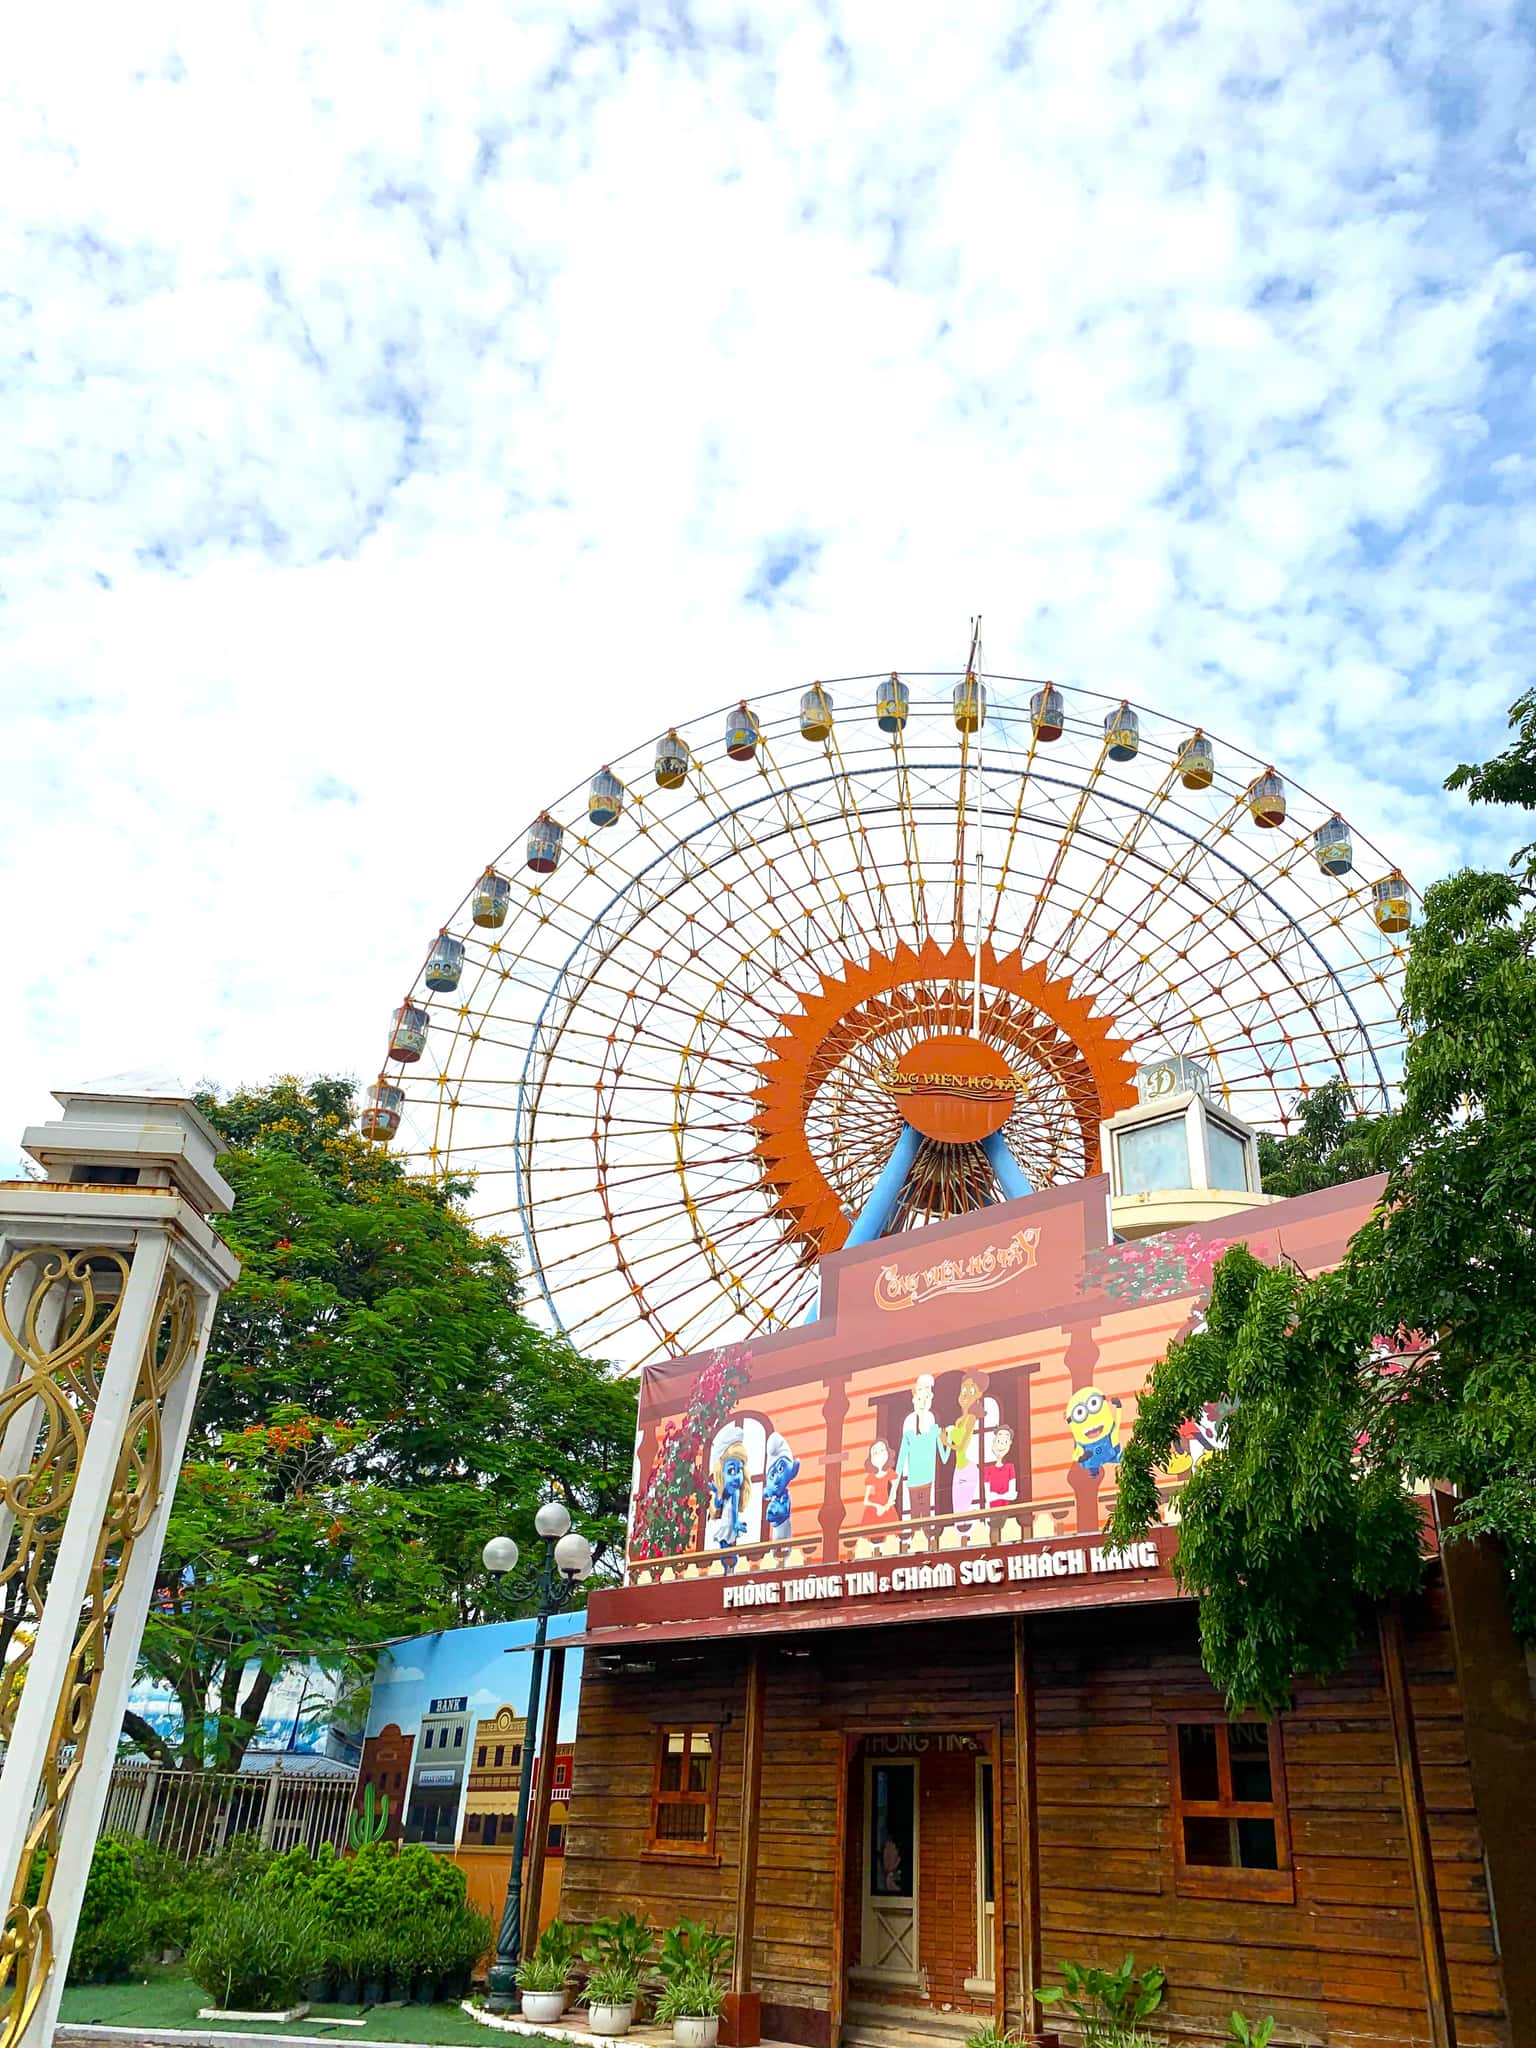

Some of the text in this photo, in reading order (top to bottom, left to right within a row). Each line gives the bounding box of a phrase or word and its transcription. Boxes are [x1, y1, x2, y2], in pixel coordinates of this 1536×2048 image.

[723, 1580, 781, 1609] PHÒNG
[782, 1574, 844, 1603] THÔNG
[845, 1570, 878, 1596] TIN
[879, 1576, 892, 1592] &
[959, 1554, 1004, 1585] SÓC
[1007, 1545, 1087, 1581] KHÁCH
[436, 1698, 461, 1712] BANK
